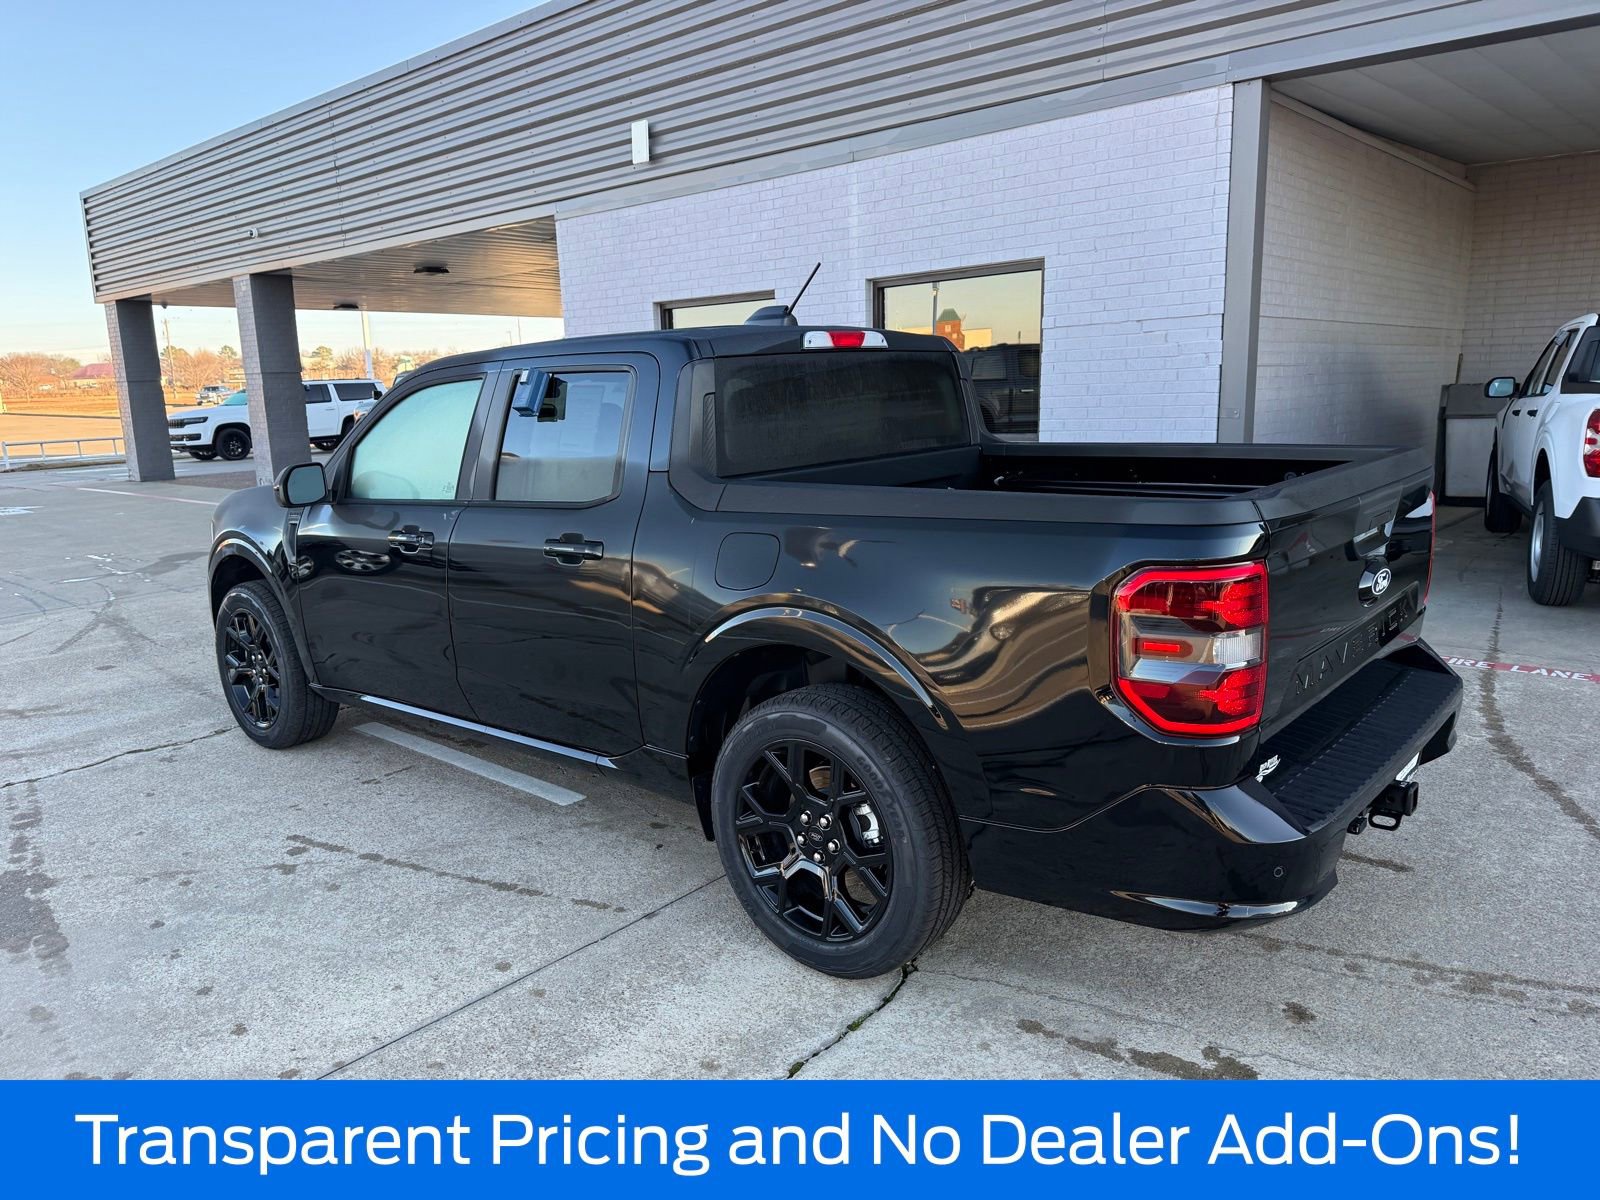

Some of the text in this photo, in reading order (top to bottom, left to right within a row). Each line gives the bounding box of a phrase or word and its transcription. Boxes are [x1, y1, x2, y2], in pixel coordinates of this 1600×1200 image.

[1374, 570, 1390, 593] Ford
[1510, 665, 1592, 682] LANE
[856, 756, 905, 839] GOODYEAR
